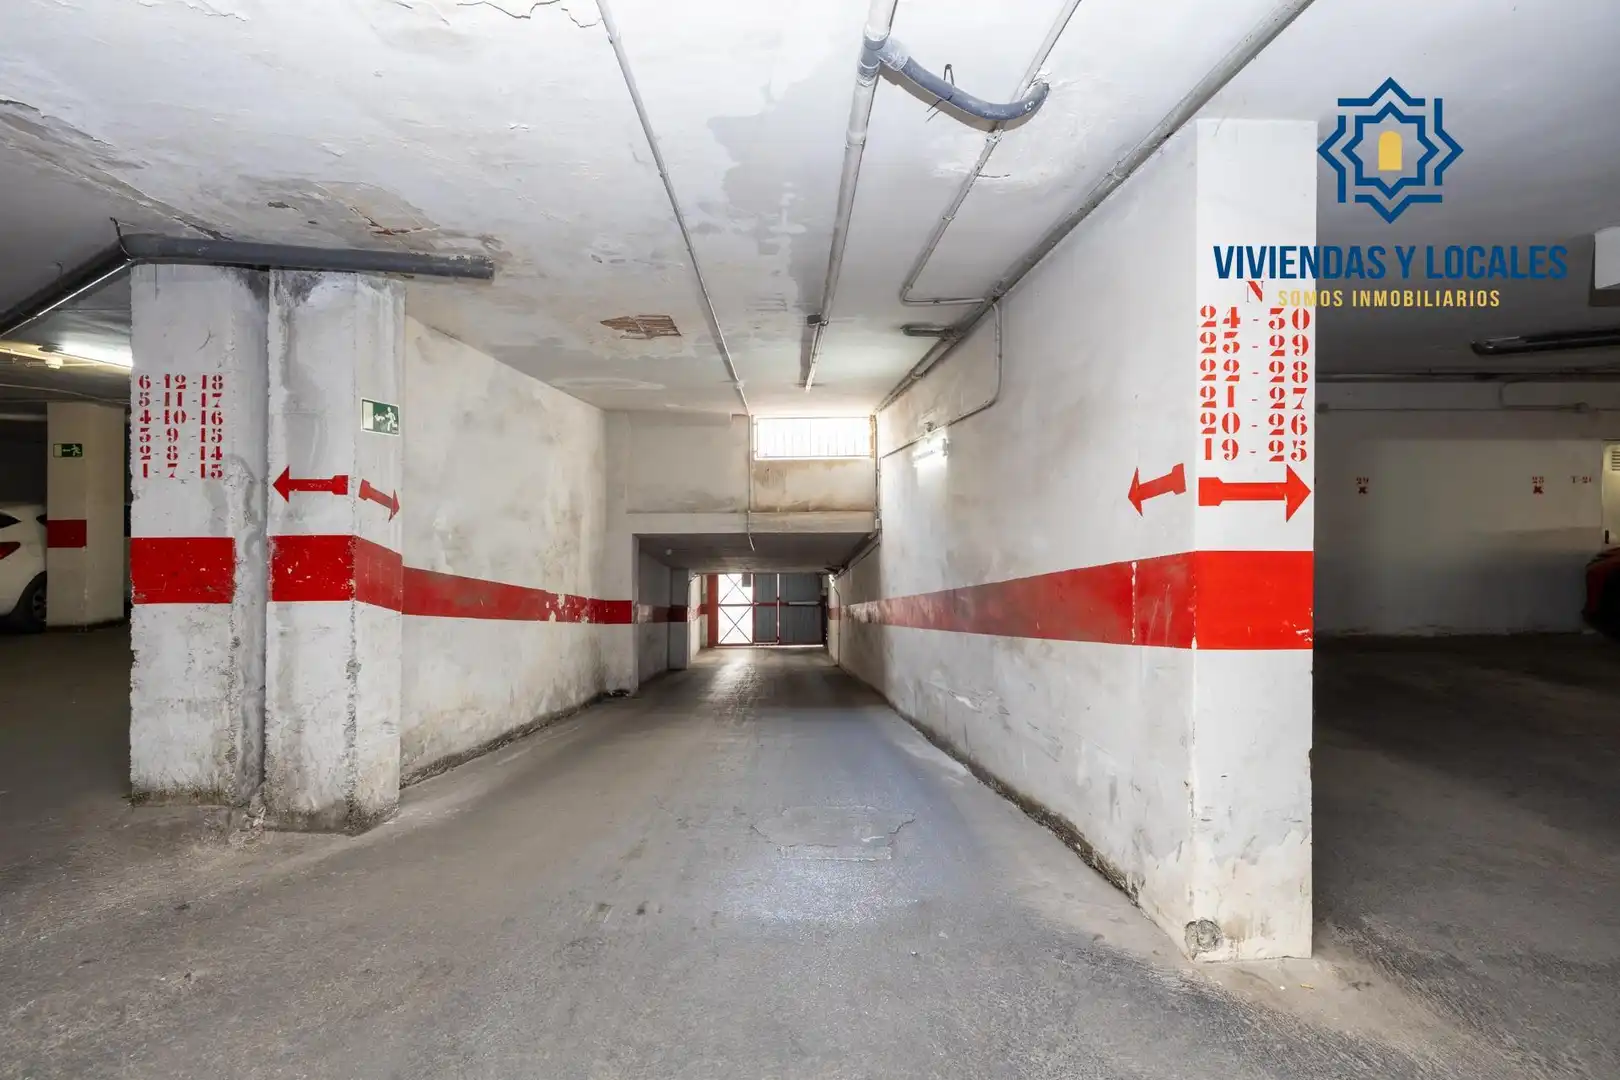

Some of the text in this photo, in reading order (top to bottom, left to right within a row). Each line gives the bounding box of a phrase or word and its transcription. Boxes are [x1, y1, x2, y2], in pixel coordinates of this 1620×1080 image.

[1200, 305, 1241, 328] 24
[1269, 307, 1310, 330] 30
[1200, 331, 1240, 354] 23
[1269, 334, 1309, 356] 29
[1200, 358, 1240, 381] 22
[1269, 361, 1308, 383] 28
[139, 375, 151, 389] 6
[164, 374, 186, 389] 12
[202, 375, 223, 390] 18
[139, 392, 151, 407] 5
[164, 392, 182, 407] 11
[201, 393, 222, 408] 17
[1200, 385, 1235, 408] 21
[1269, 386, 1308, 410] 27
[139, 410, 151, 424] 4
[164, 410, 187, 424] 10
[201, 411, 223, 425] 16
[1200, 412, 1240, 434] 20
[1268, 413, 1308, 435] 26
[139, 428, 151, 443] 3
[167, 428, 179, 443] 9
[201, 428, 223, 443] 15
[139, 445, 151, 460] 2
[166, 445, 179, 460] 8
[200, 446, 222, 460] 14
[1204, 438, 1239, 460] 19
[1268, 440, 1307, 462] 25
[143, 463, 148, 478] 1
[167, 463, 178, 478] 7
